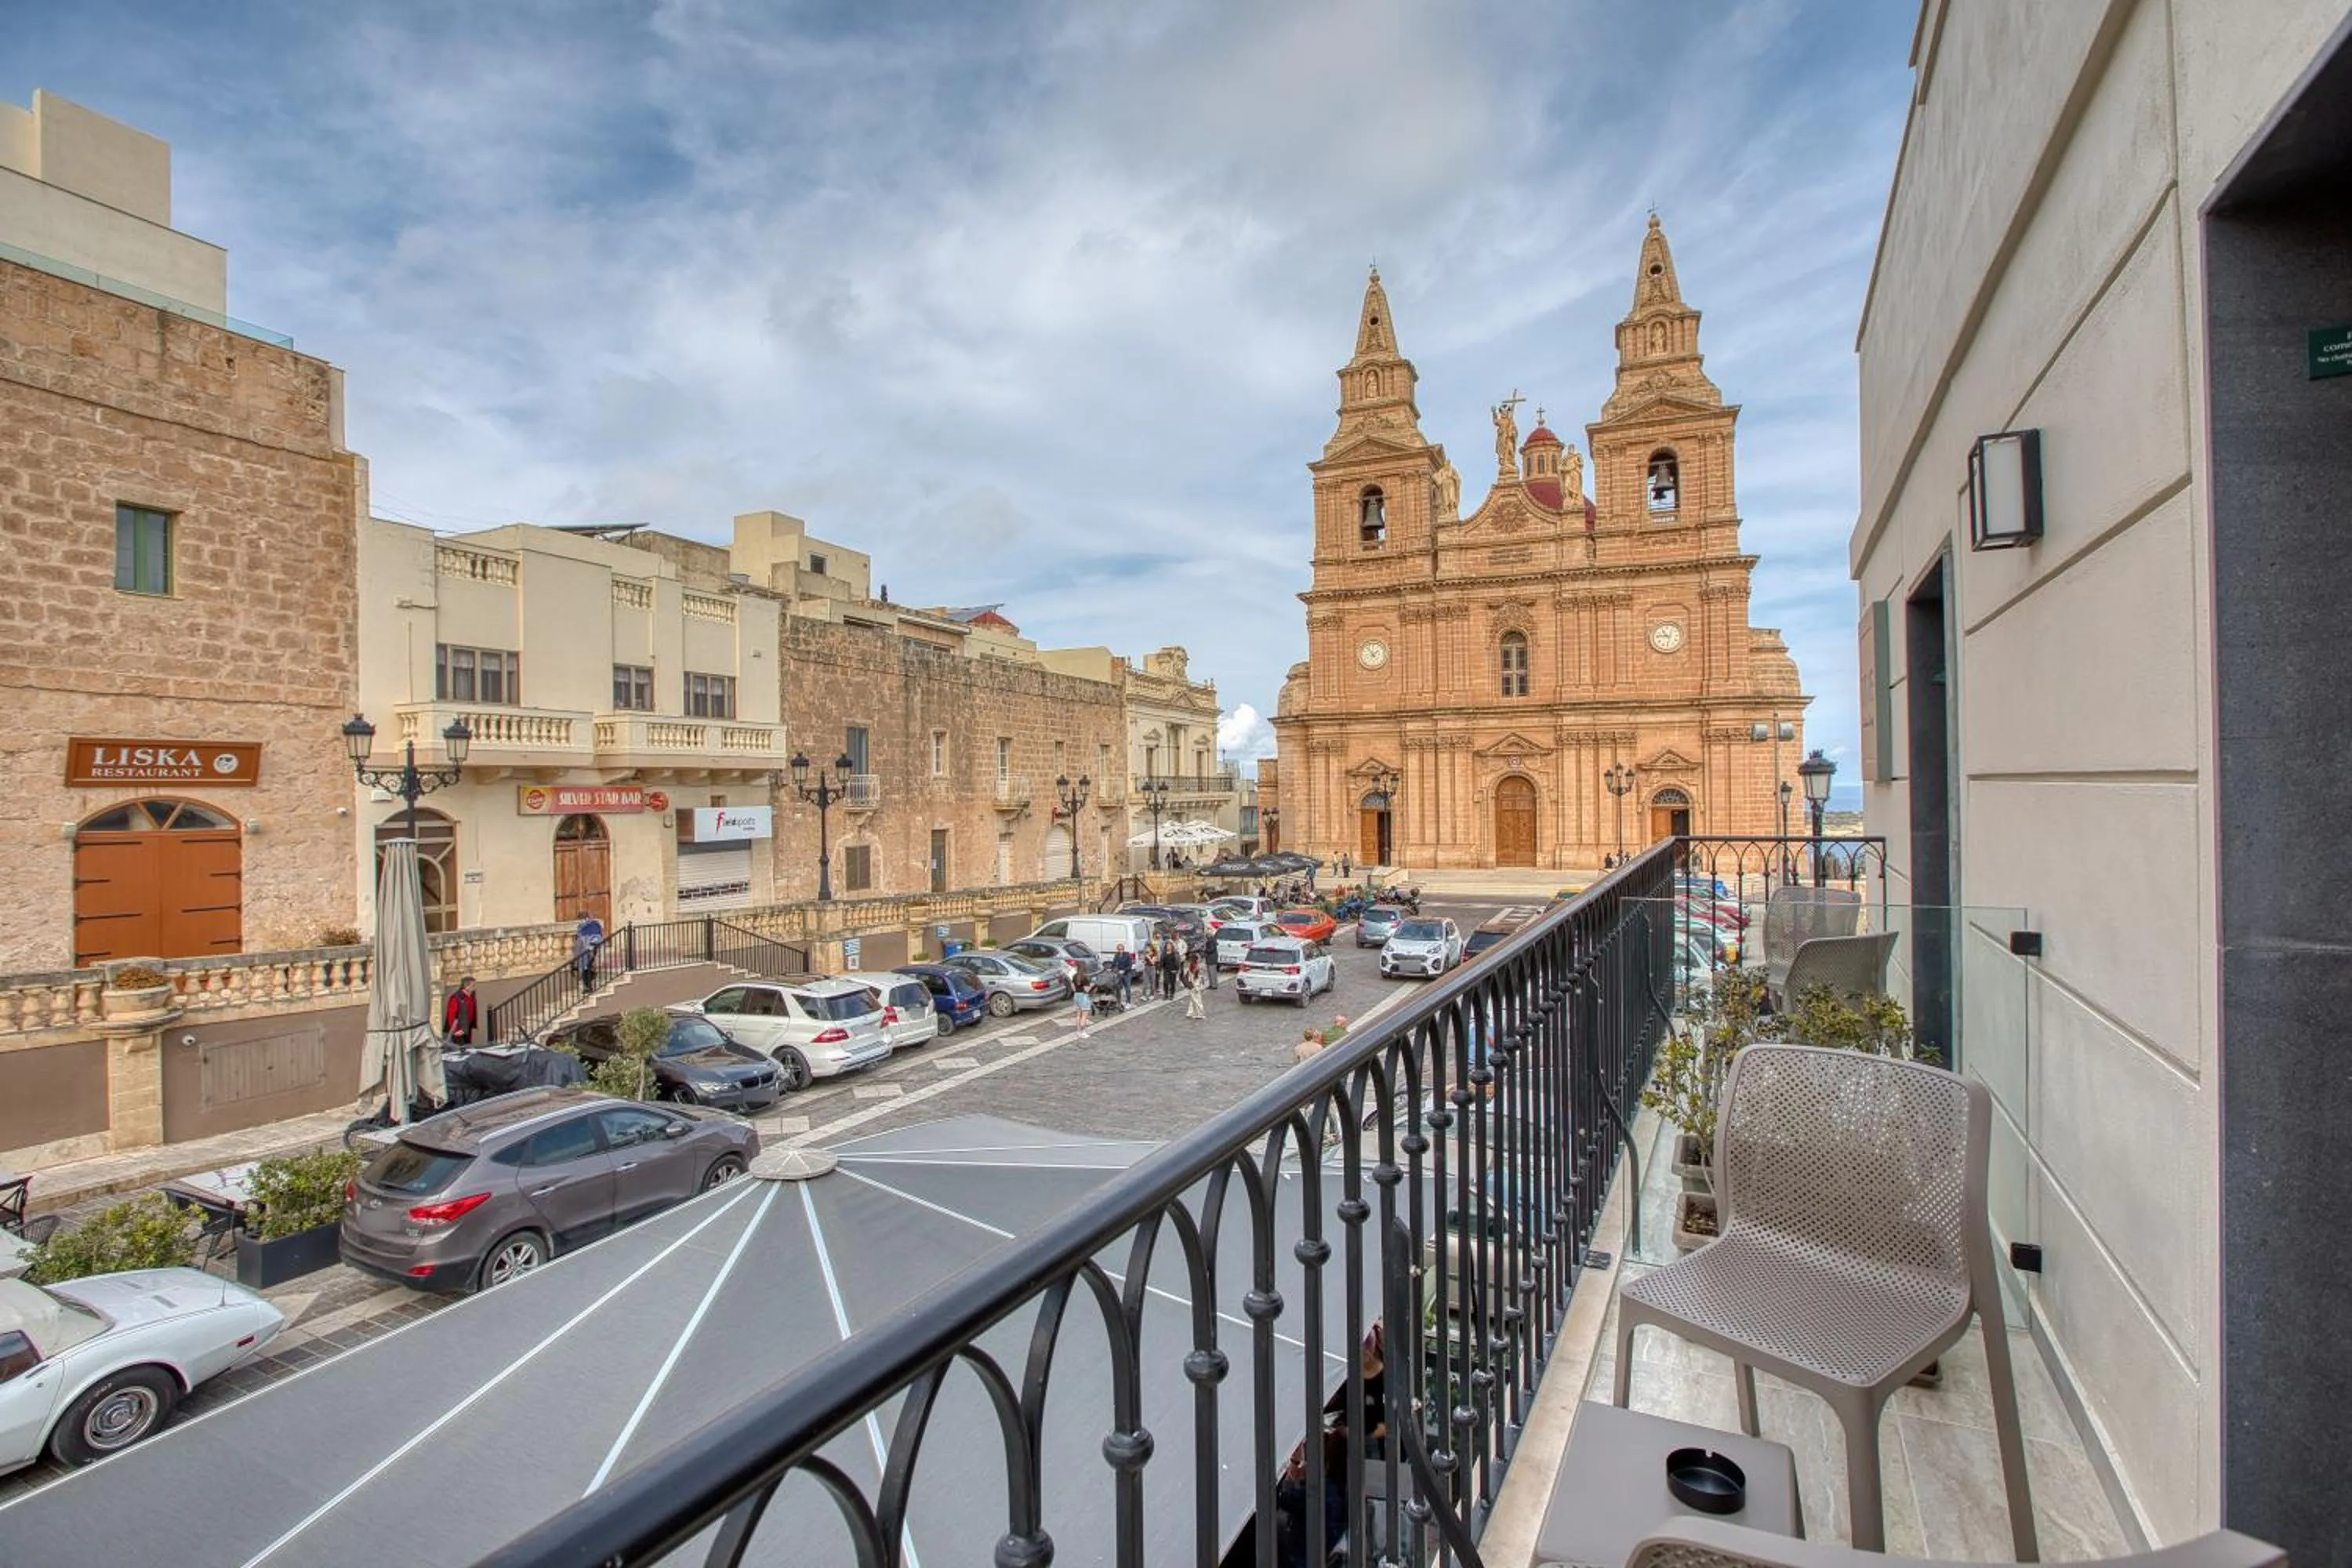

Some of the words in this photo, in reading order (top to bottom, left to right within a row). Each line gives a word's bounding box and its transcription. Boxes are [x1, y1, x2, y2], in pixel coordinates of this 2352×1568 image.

[93, 746, 201, 766] LISKA
[91, 767, 201, 777] RESTAURANT
[558, 791, 591, 805] SILVER
[593, 791, 619, 805] STAR
[622, 791, 642, 804] BAR
